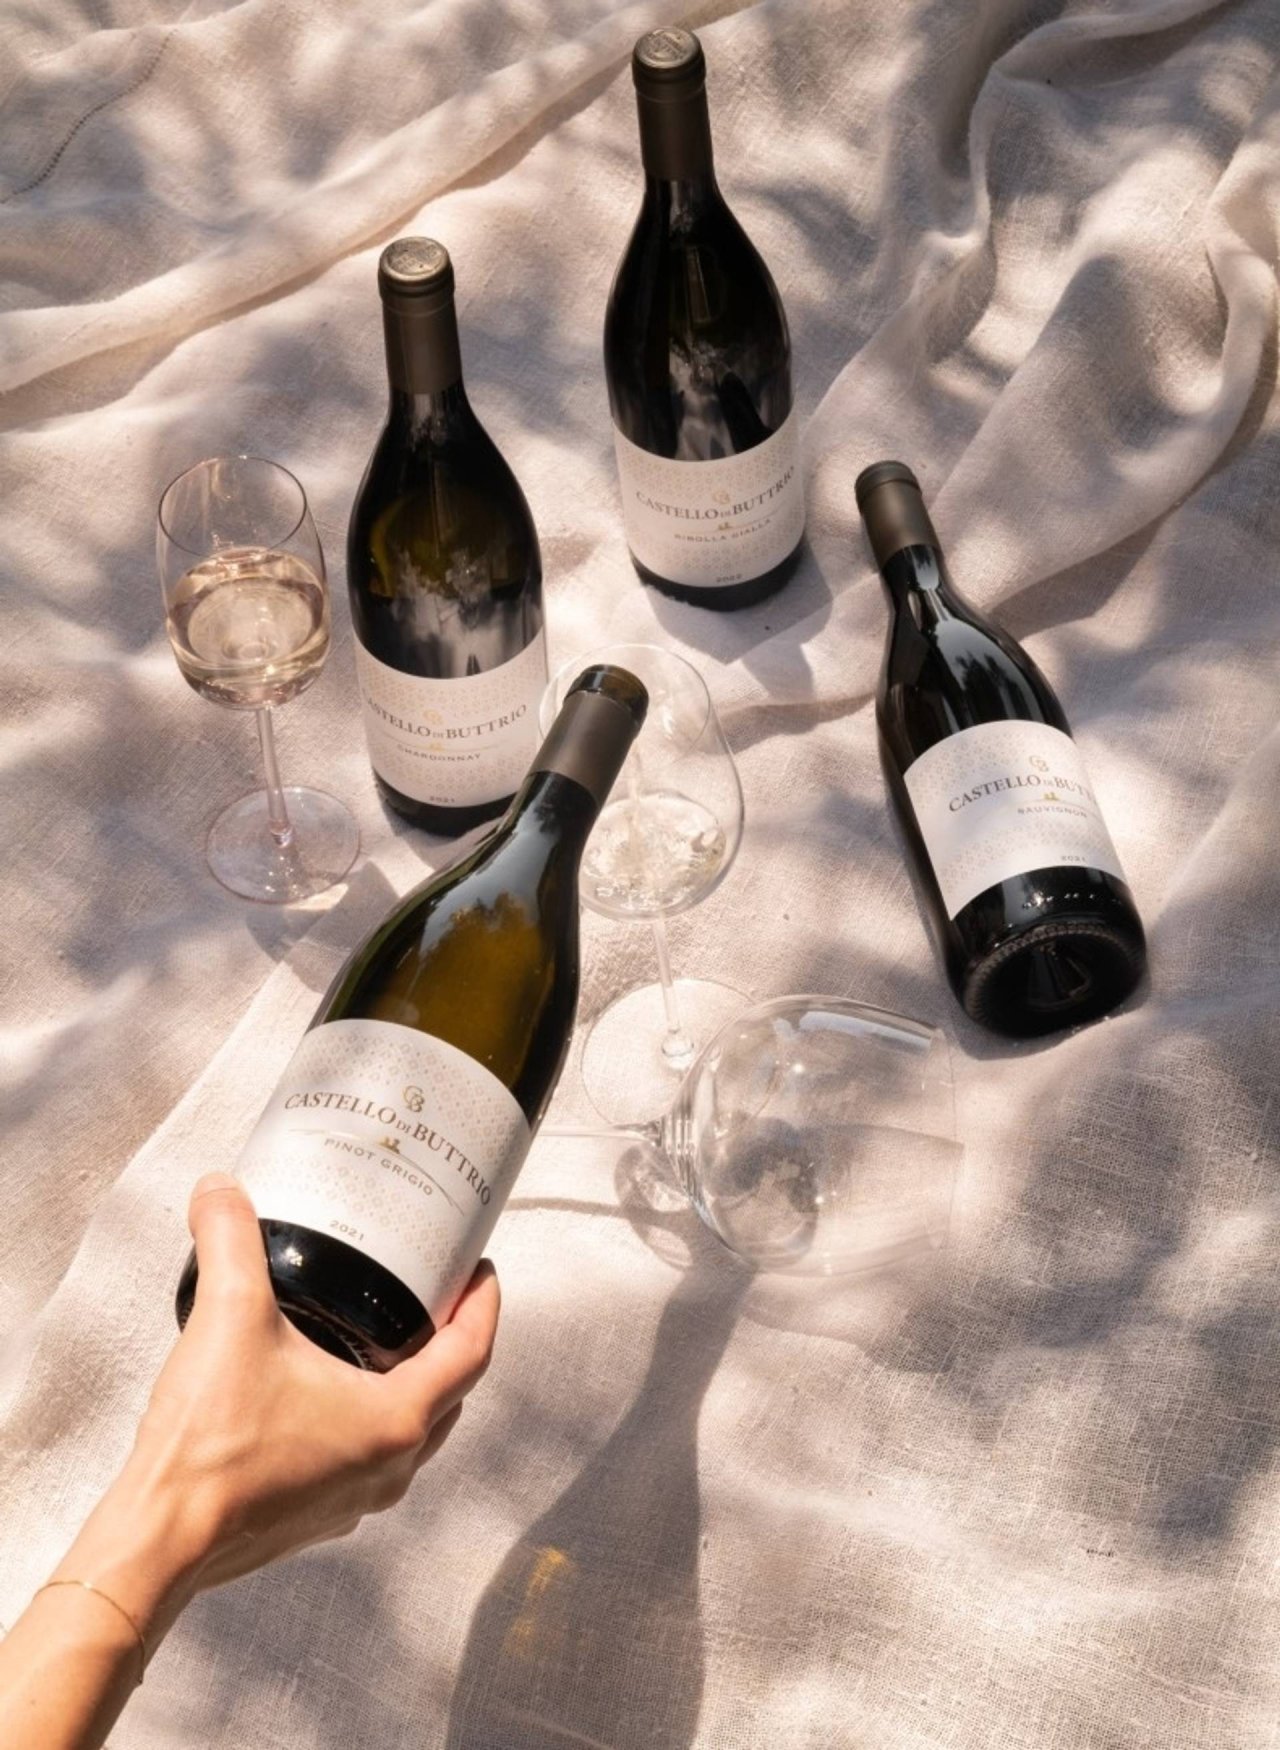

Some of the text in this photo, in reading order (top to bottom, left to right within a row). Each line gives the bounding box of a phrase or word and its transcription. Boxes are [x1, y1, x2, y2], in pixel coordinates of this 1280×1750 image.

[635, 491, 719, 520] CASTELLO
[446, 704, 527, 739] BUTTRIO
[948, 774, 1041, 813] CASTELLO
[284, 1092, 492, 1207] CASTELLO DI BUTTRIO
[323, 1138, 434, 1196] PINOT GRIGIO
[329, 1219, 366, 1242] 2021
